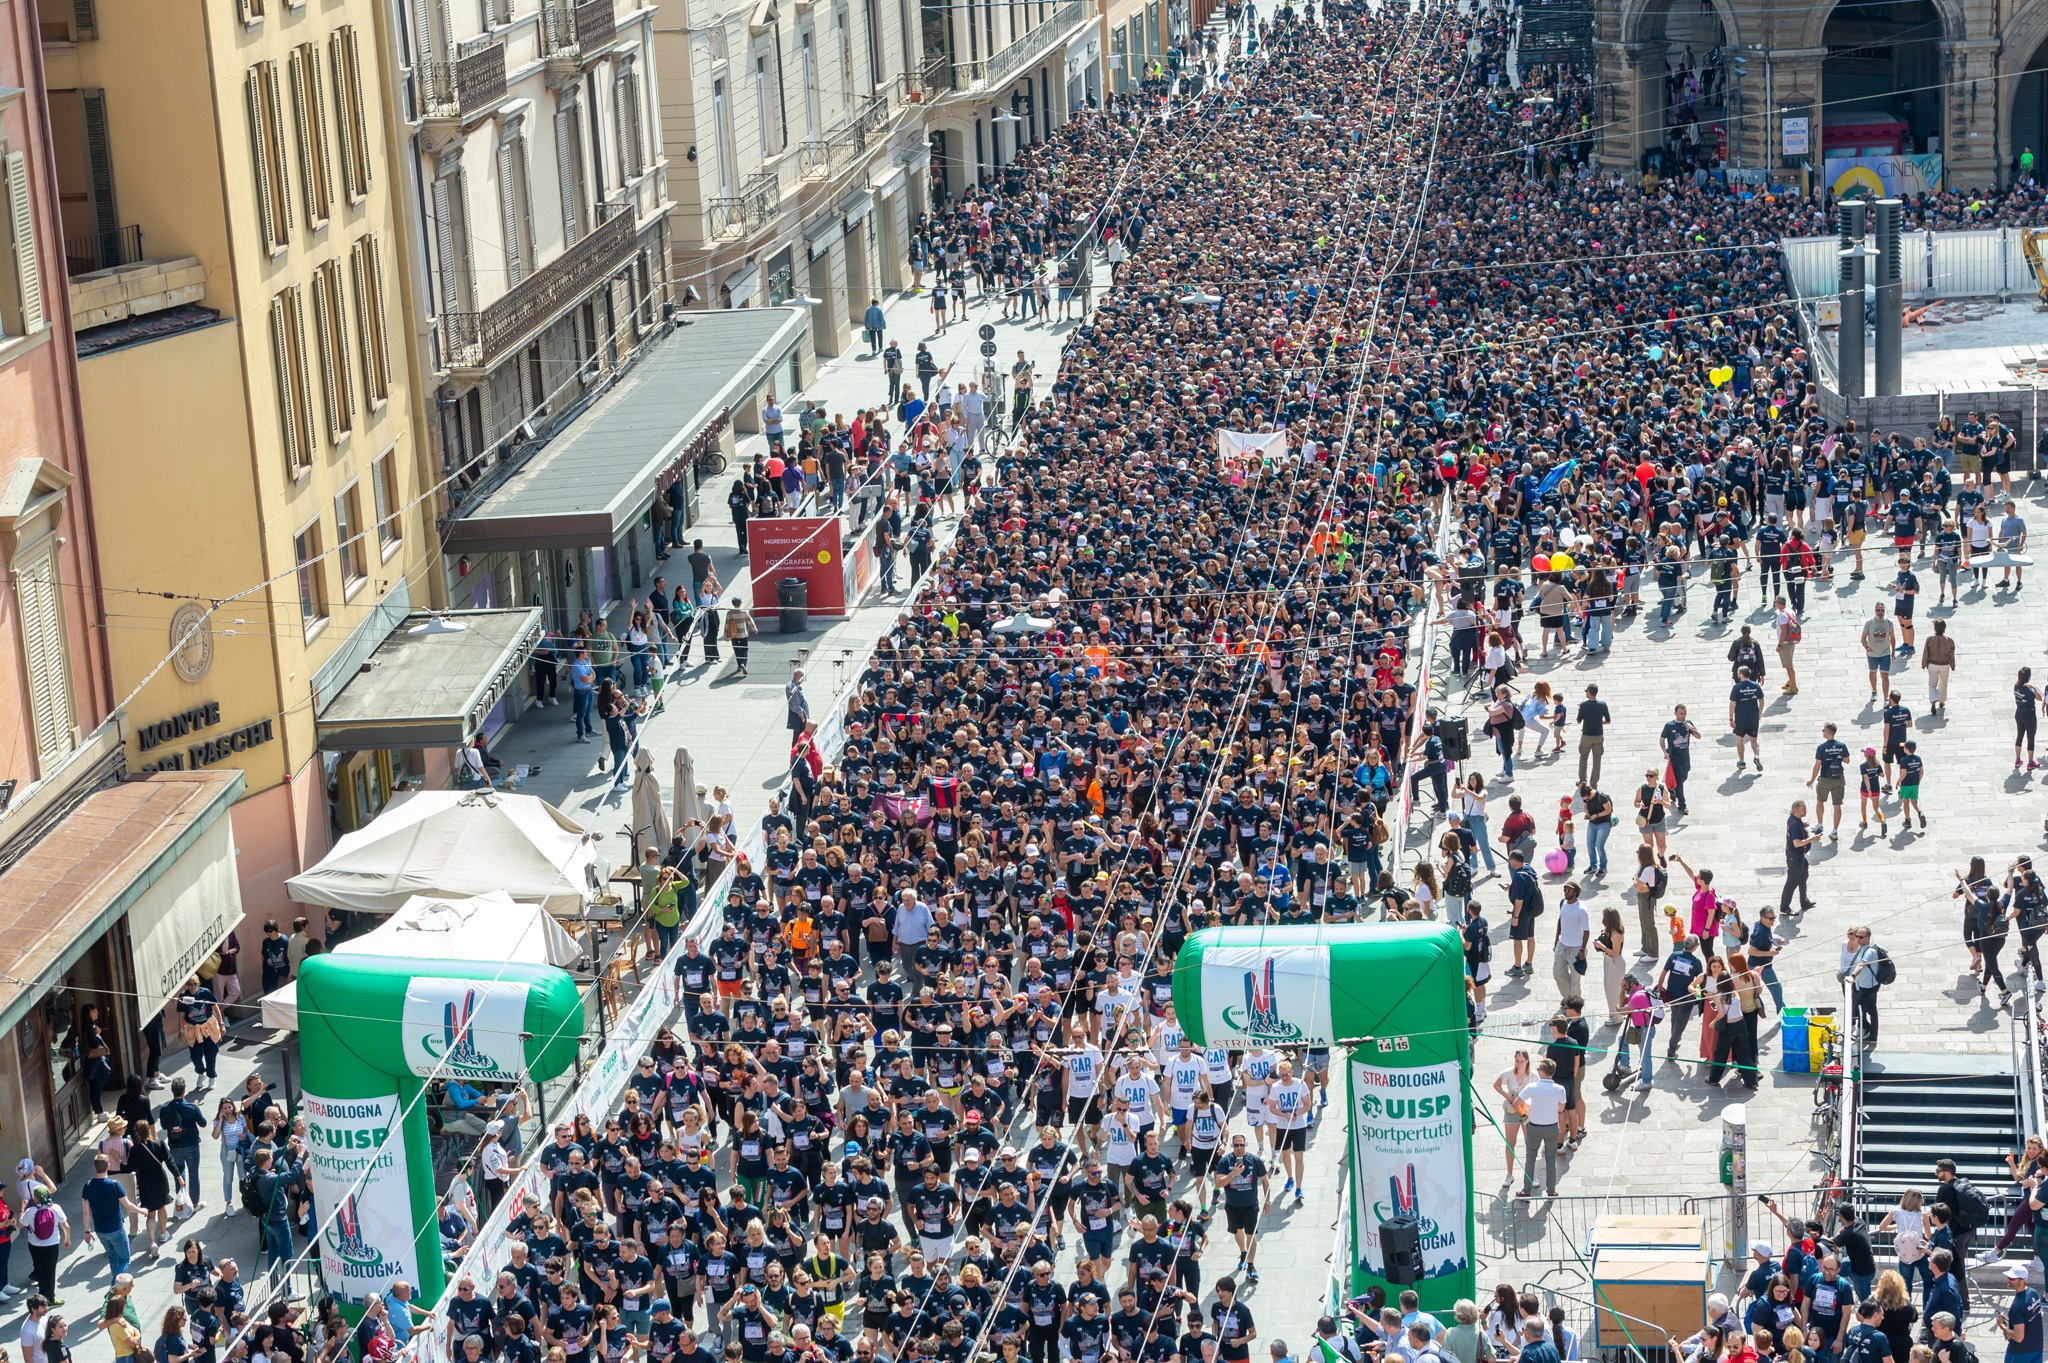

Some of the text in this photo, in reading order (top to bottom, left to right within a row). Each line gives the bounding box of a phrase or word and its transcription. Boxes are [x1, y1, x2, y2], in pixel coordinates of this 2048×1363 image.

[1877, 161, 1936, 178] CINEMA
[1309, 651, 1319, 659] 14
[138, 701, 221, 751] MONTE
[189, 719, 274, 770] PASCHI
[160, 914, 224, 997] CAFFETTERIA
[1378, 1042, 1391, 1051] 14
[1396, 1041, 1408, 1050] 15
[1207, 1048, 1226, 1063] CAR
[1070, 1057, 1092, 1073] CAR
[1250, 1061, 1270, 1078] CAR
[1176, 1069, 1196, 1085] CAR
[1363, 1070, 1446, 1088] STRABOLOGNA
[1125, 1087, 1146, 1102] CAR
[1279, 1091, 1299, 1108] CAR
[307, 1100, 383, 1119] STRABOLOGNA
[1385, 1094, 1451, 1119] UISP
[1195, 1117, 1215, 1131] CAR
[1361, 1120, 1453, 1145] sportpertutti
[325, 1127, 390, 1149] UISP
[1375, 1145, 1404, 1154] Comitato
[1414, 1145, 1441, 1155] Bologna
[321, 1173, 345, 1183] Comitato
[323, 1254, 404, 1279] STRABOLOGNA
